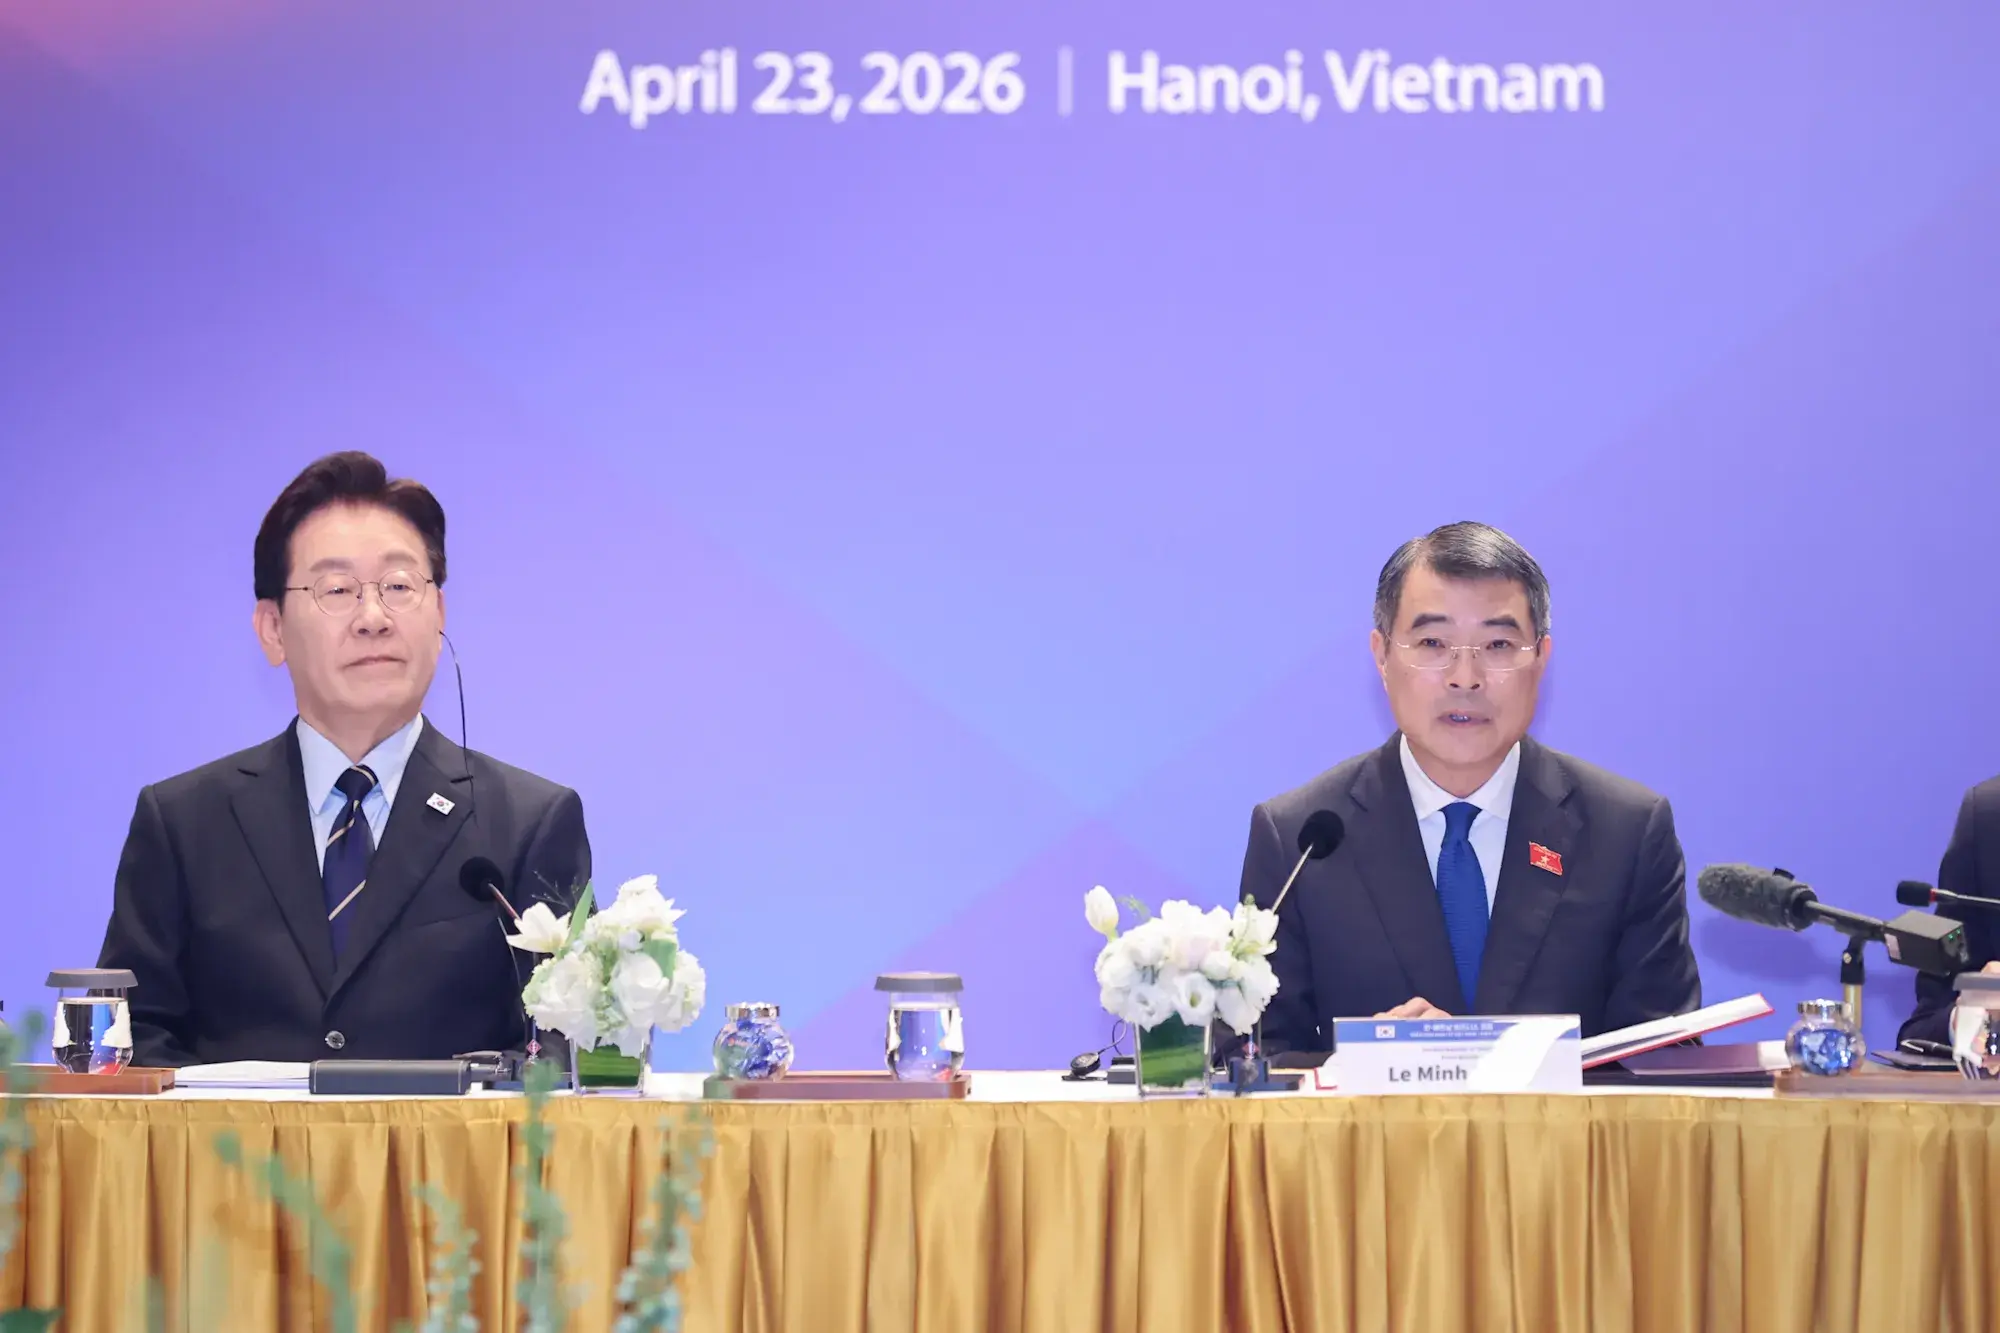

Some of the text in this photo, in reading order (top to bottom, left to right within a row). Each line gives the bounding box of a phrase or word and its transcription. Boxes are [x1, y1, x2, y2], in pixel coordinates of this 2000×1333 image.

[580, 47, 1604, 130] April 23, 2026 Hanoi, Vietnam
[1388, 1064, 1468, 1082] Le Minh
